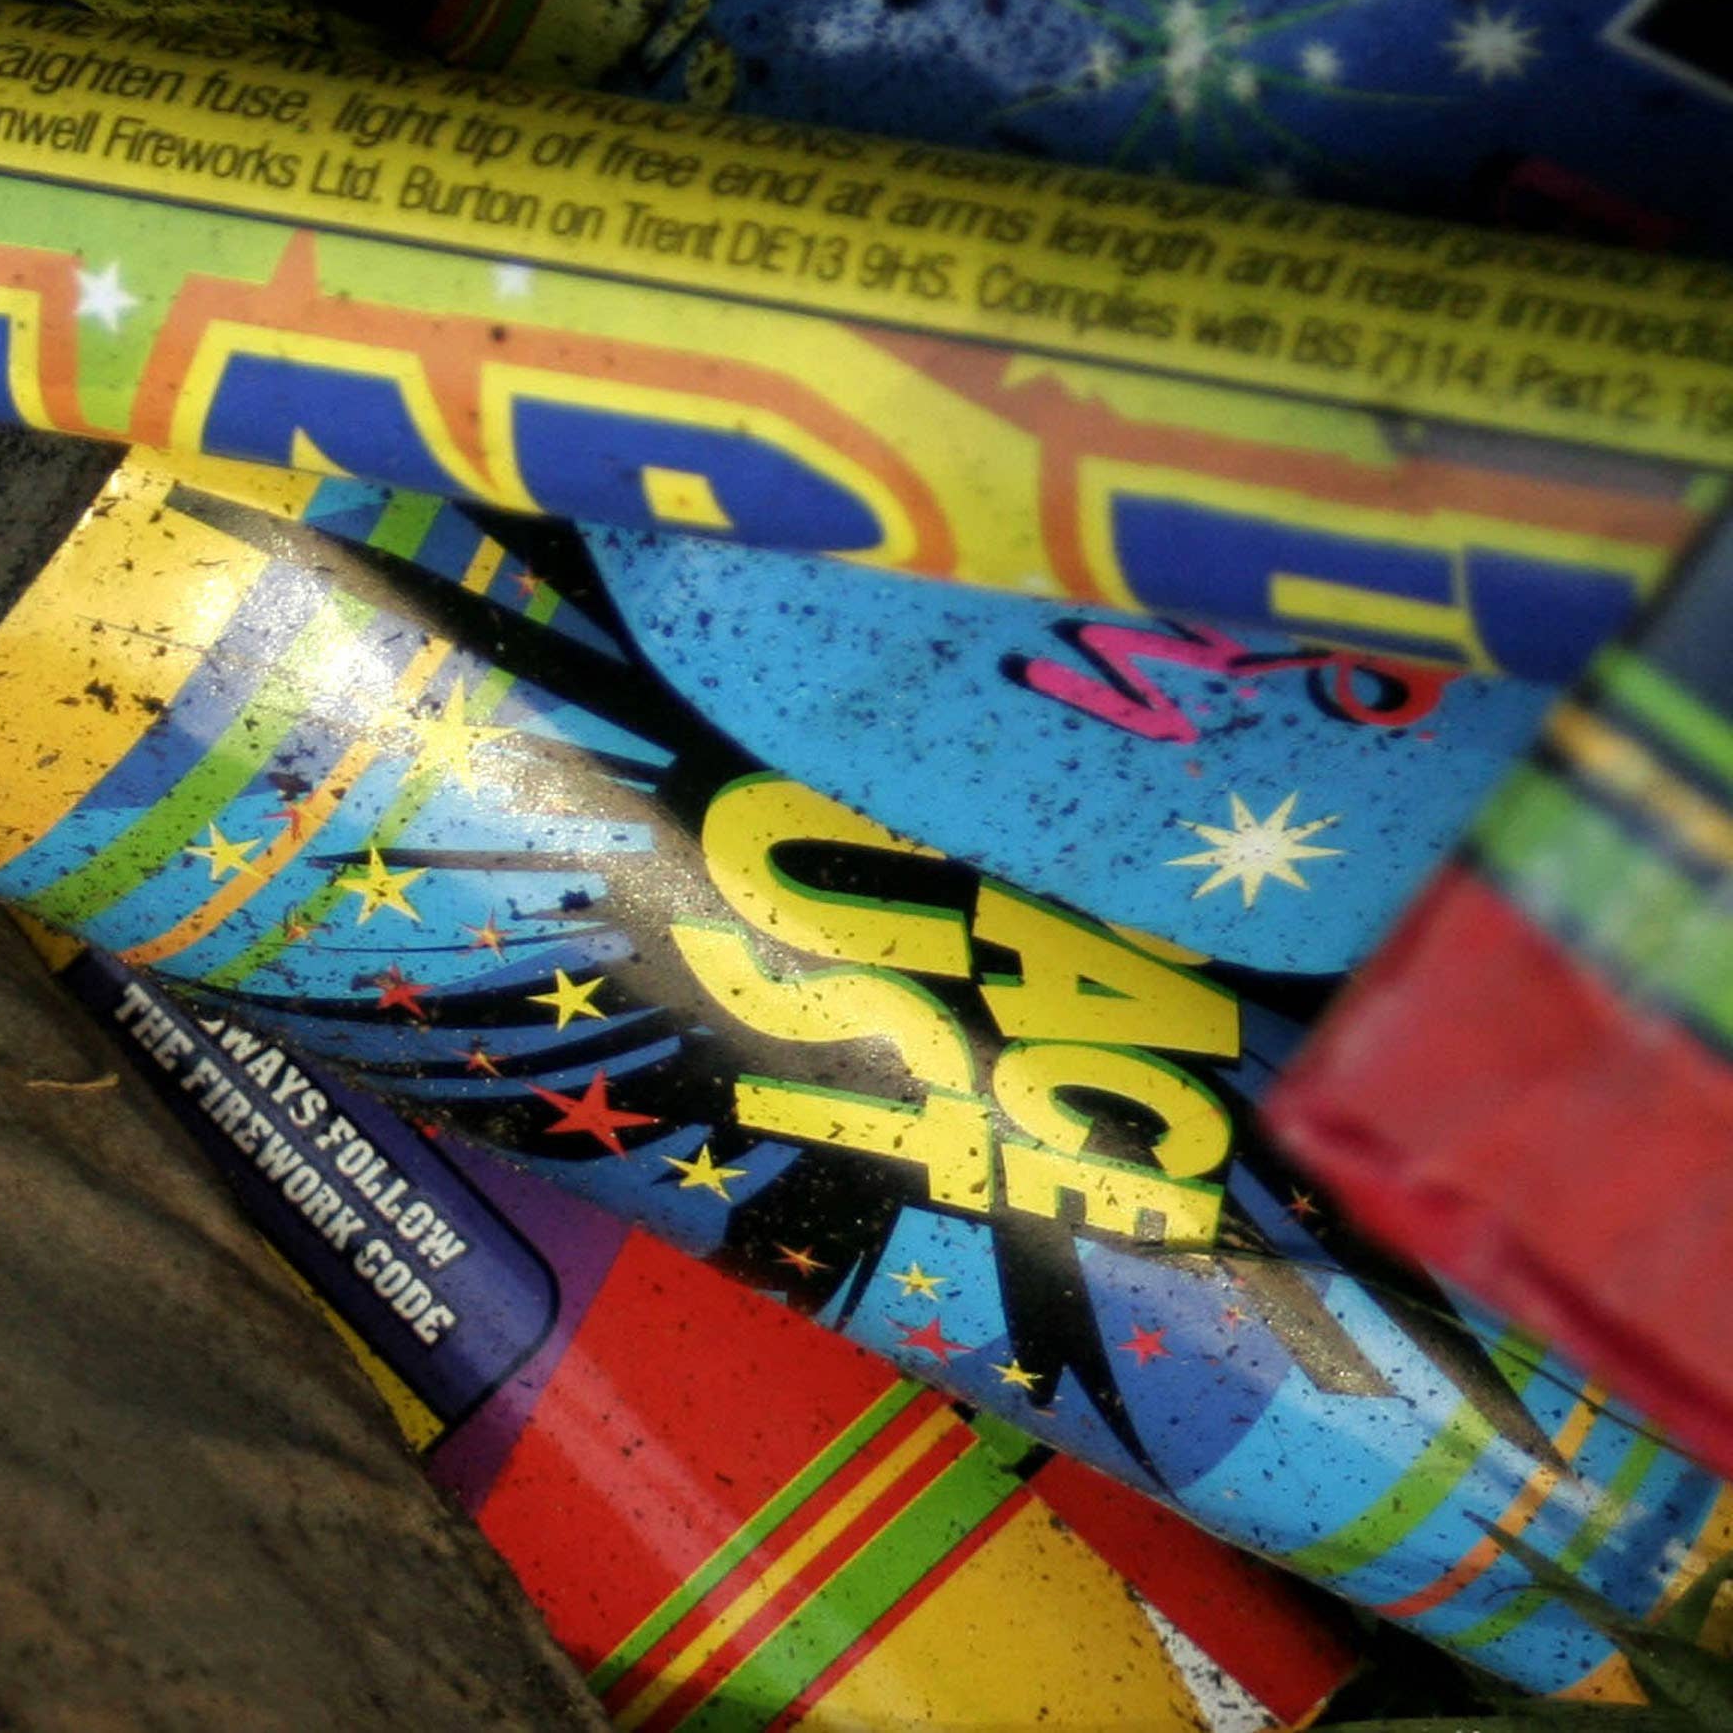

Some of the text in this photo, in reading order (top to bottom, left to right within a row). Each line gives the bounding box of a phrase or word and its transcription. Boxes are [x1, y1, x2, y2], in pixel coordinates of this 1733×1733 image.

[101, 111, 305, 192] Fireworks
[308, 148, 390, 206] Ltd.
[396, 162, 543, 232] Burton
[547, 196, 608, 243] on
[618, 198, 723, 262] Trent
[724, 216, 854, 286] DE13
[192, 66, 316, 134] fuse,
[328, 88, 452, 160] light
[452, 111, 523, 173] tip
[529, 122, 601, 177] of
[596, 135, 704, 192] free
[707, 154, 823, 211] end
[822, 175, 887, 225] at
[887, 188, 1033, 249] arms
[103, 979, 459, 1347] THE FIREWORK CODE
[196, 995, 469, 1275] WAYS FOLLOW
[971, 874, 1241, 1250] ACE
